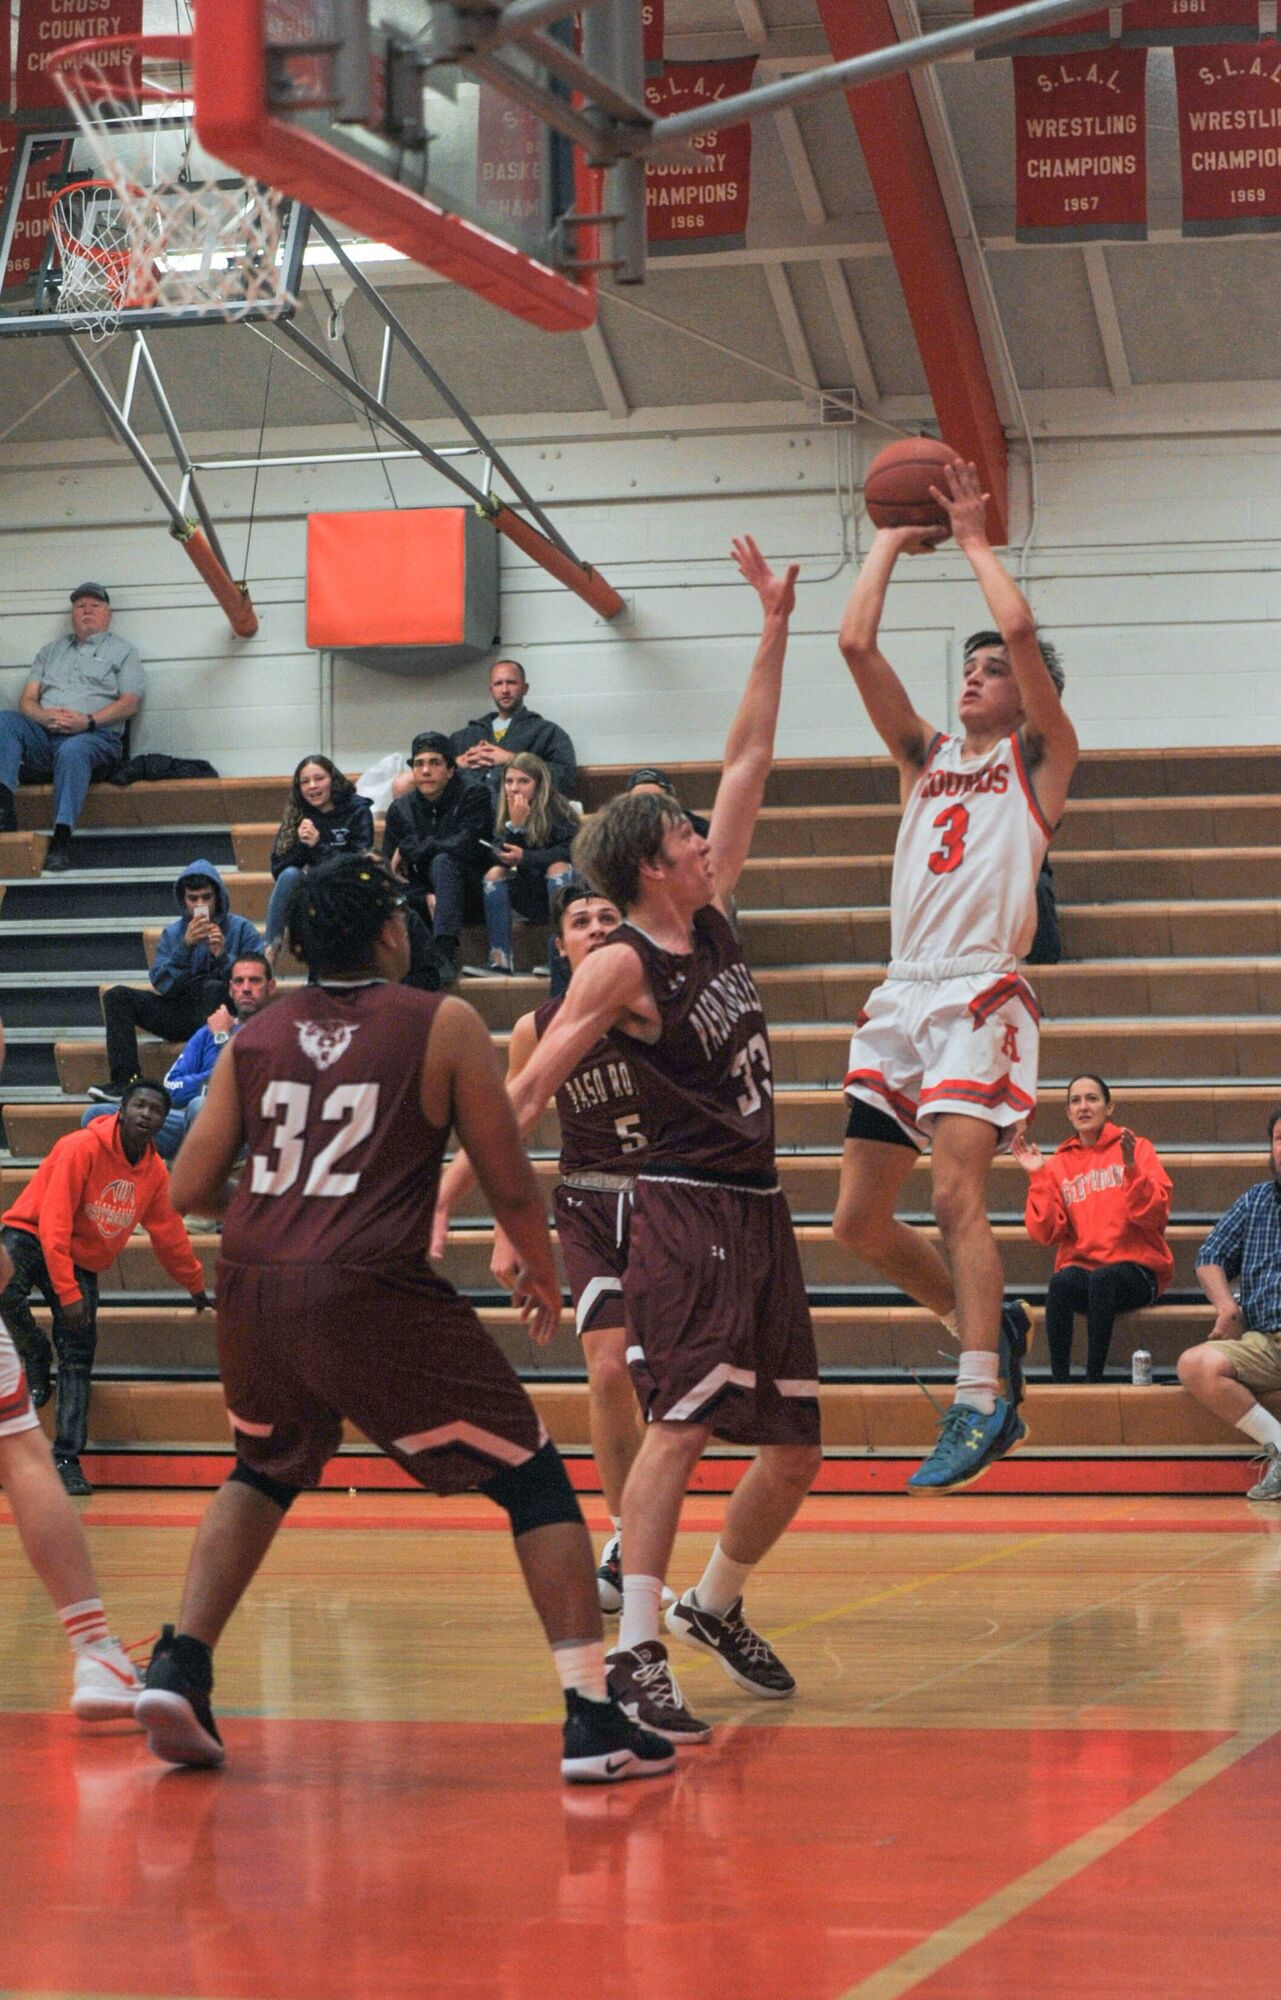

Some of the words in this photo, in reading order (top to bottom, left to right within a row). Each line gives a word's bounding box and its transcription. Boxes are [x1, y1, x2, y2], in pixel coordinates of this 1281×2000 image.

[39, 16, 121, 40] COUNTRY
[1026, 114, 1137, 139] WRESTLING
[1027, 154, 1136, 179] CHAMPIONS
[1064, 196, 1099, 212] 1967
[1230, 188, 1266, 203] 1969
[671, 215, 705, 229] 1966
[927, 803, 970, 876] 3
[1001, 1023, 1020, 1063] A
[250, 1080, 380, 1197] 32
[614, 1113, 648, 1154] 5
